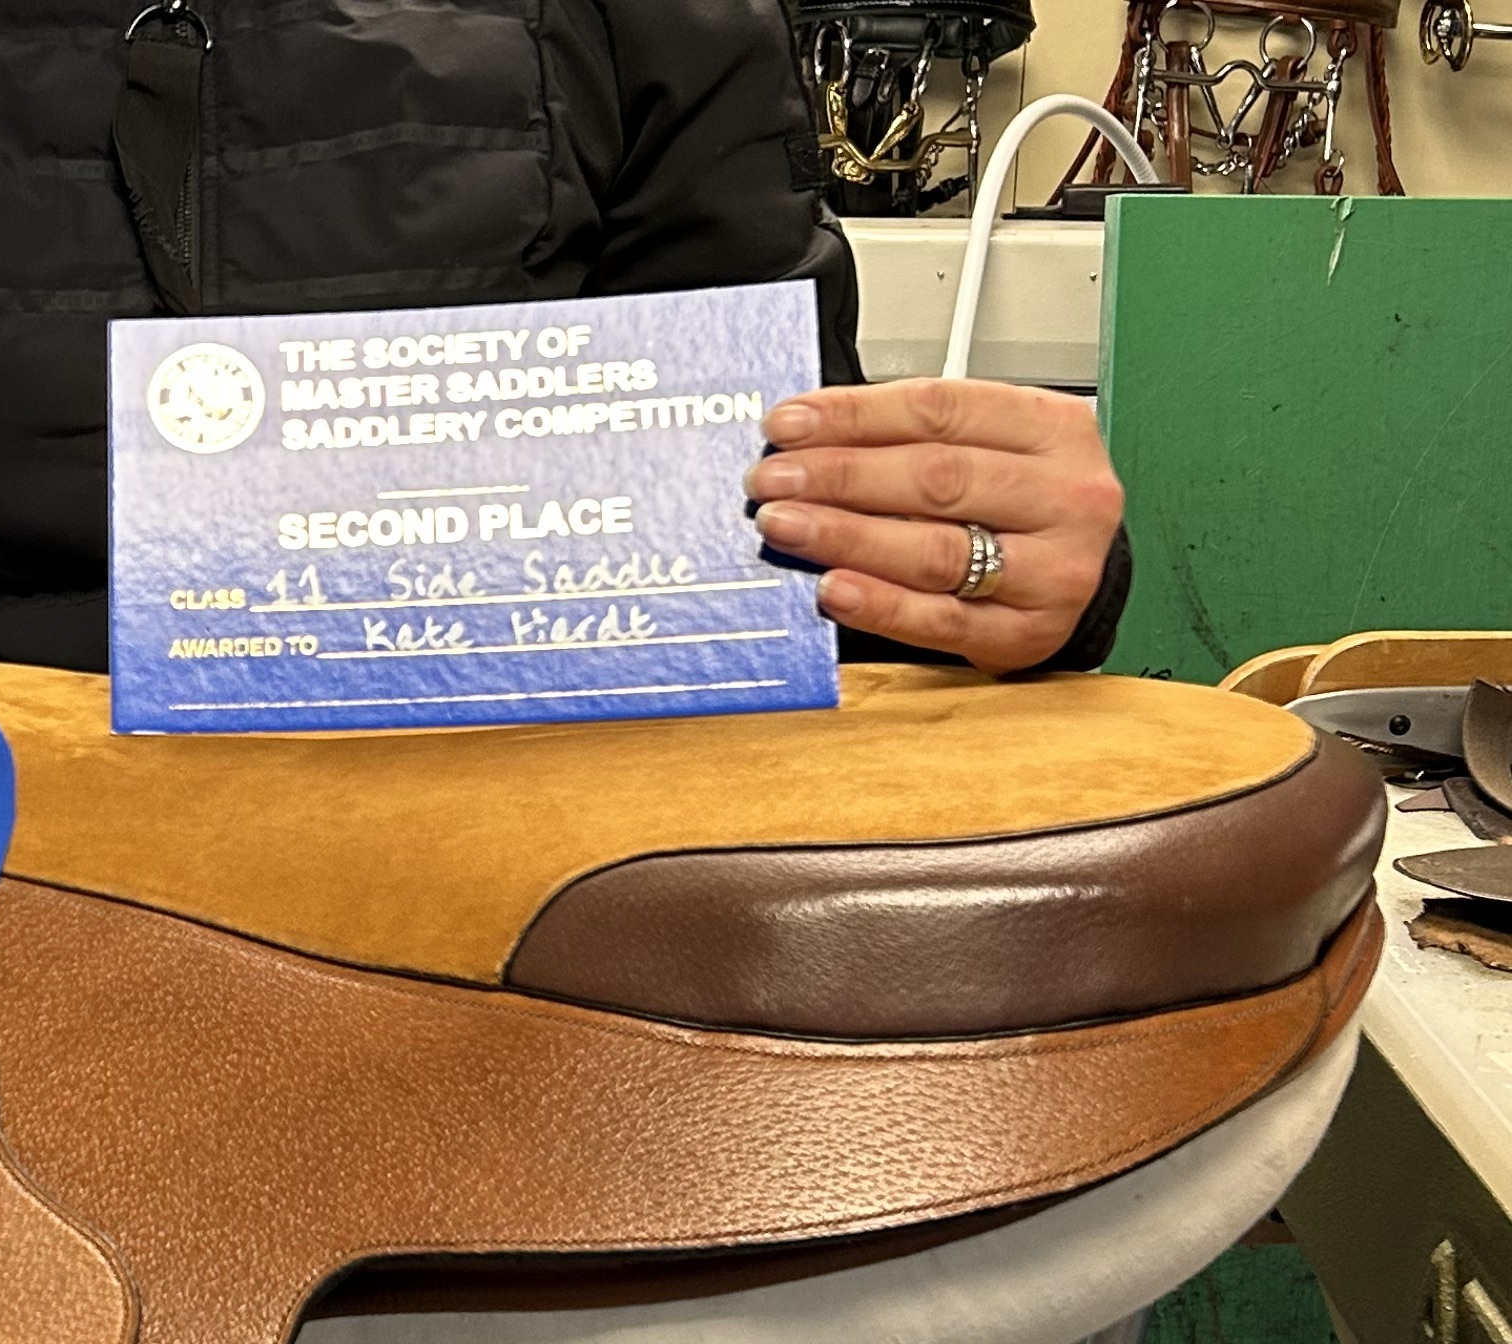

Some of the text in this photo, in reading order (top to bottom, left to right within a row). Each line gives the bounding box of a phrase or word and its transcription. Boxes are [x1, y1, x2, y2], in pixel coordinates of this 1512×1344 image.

[279, 324, 591, 372] THE SOCIETY OF
[281, 359, 658, 412] MASTER SADDLERS
[281, 391, 763, 451] SADDLERY COMPETITION
[278, 496, 633, 550] SECOND PLACE
[169, 588, 246, 610] CLASS
[265, 549, 698, 606] 11 Side Saddle
[168, 634, 319, 659] AWARDED TO
[362, 616, 475, 651] Kate
